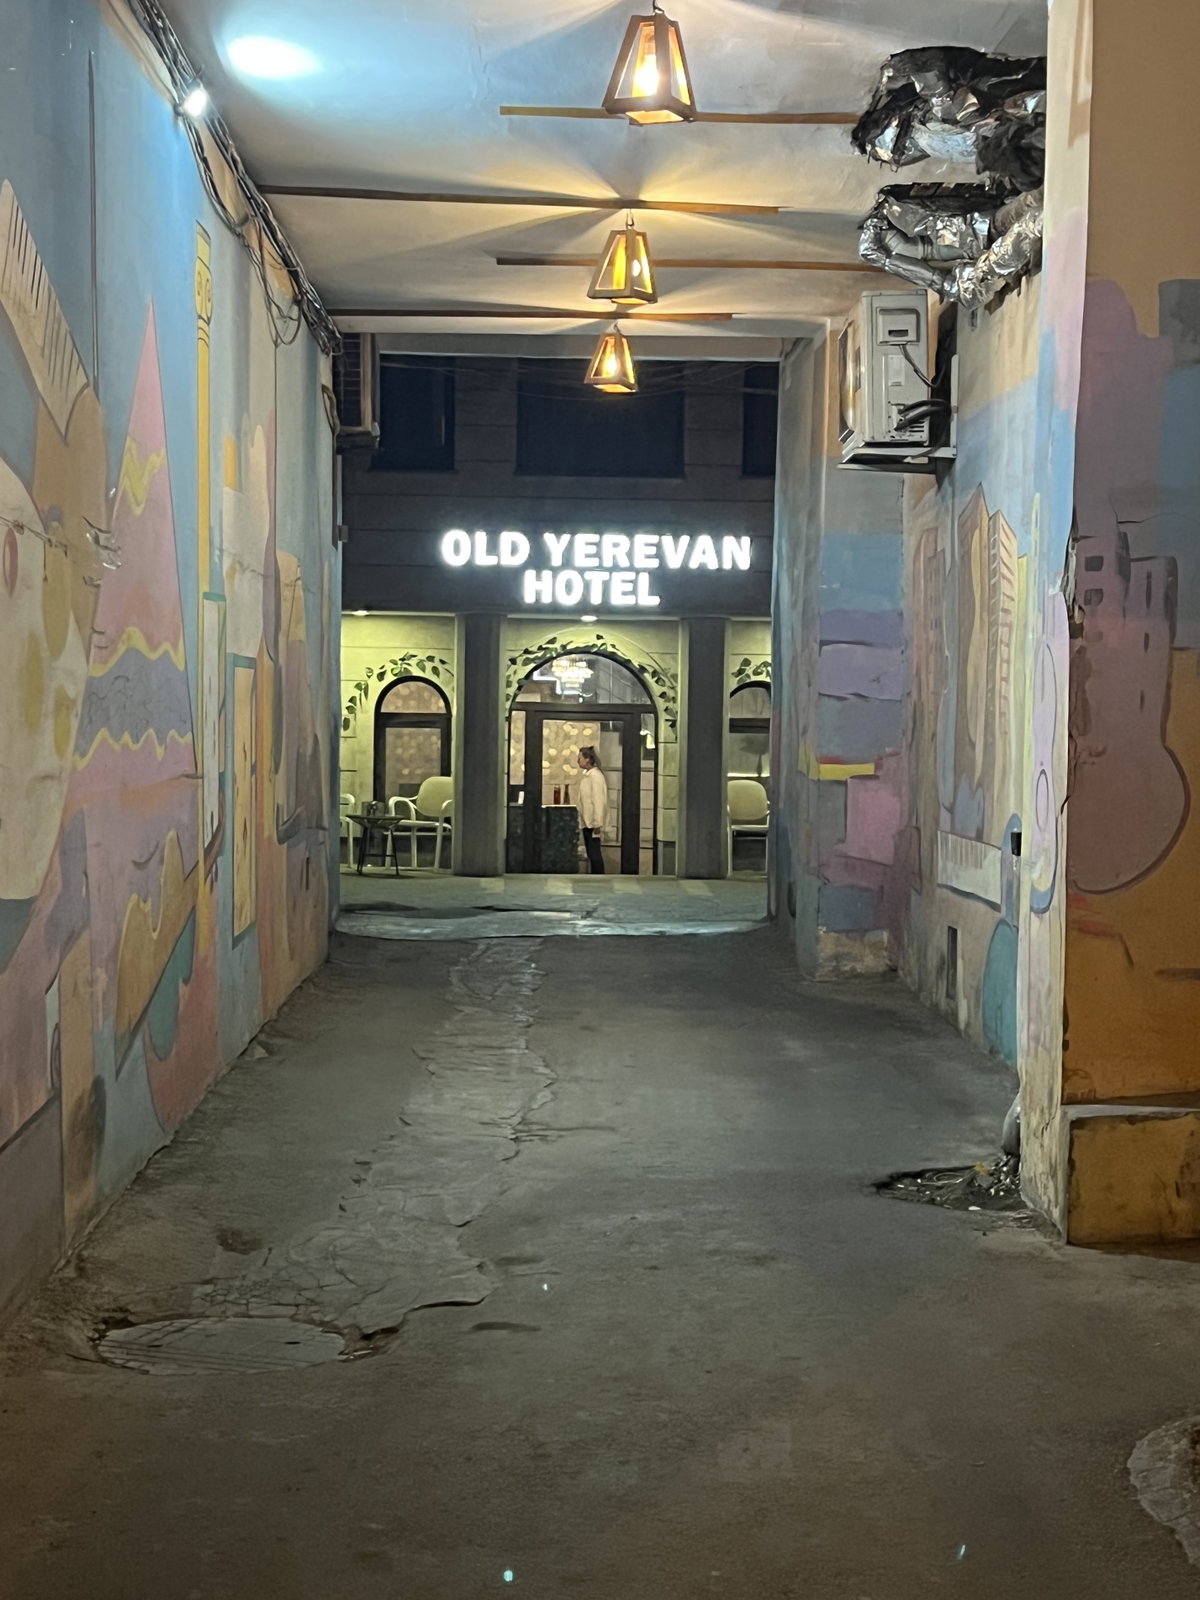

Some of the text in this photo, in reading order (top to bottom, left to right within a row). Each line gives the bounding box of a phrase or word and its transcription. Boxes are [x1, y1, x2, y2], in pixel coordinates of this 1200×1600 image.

[440, 529, 752, 571] OLD YEREVAN
[523, 569, 661, 607] HOTEL
